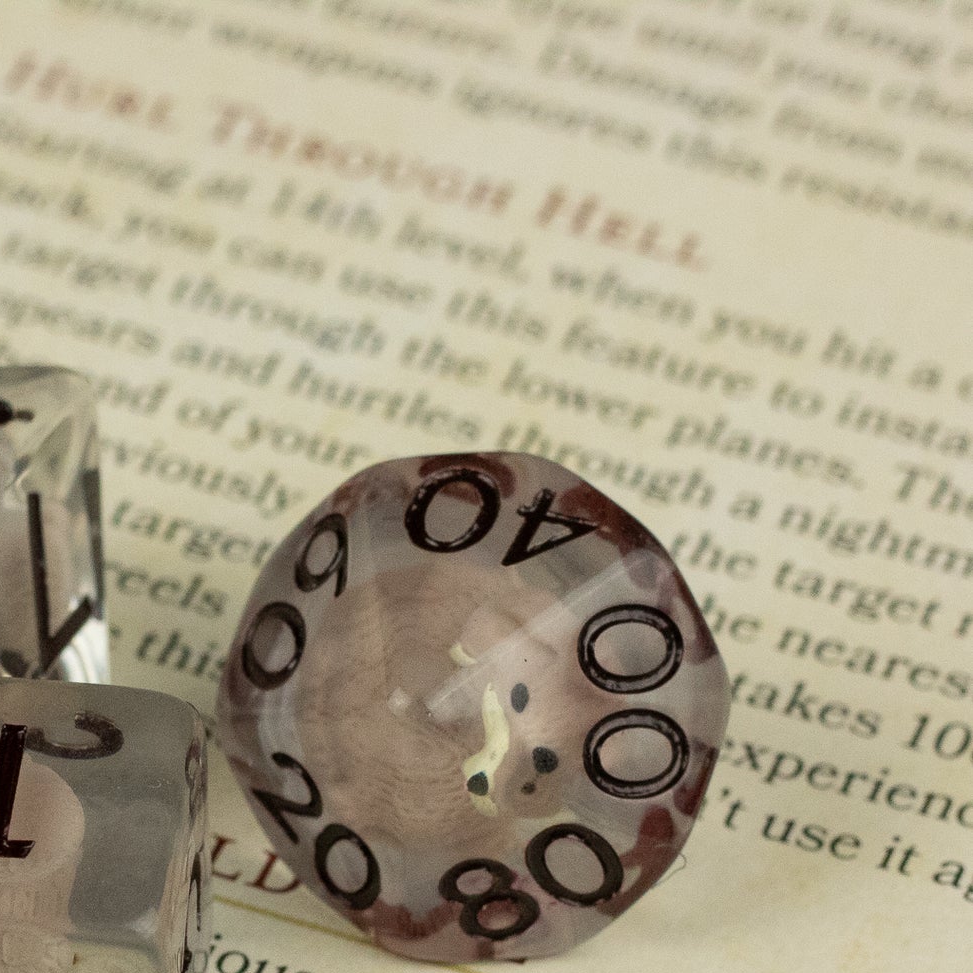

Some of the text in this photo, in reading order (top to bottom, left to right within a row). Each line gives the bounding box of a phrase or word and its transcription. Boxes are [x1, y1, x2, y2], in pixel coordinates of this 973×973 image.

[445, 290, 549, 342] this
[562, 316, 757, 395] feature
[770, 380, 825, 417] to
[549, 262, 697, 328] when
[699, 308, 810, 357] you
[822, 328, 897, 380] hit
[909, 362, 944, 392] a
[170, 272, 389, 357] through
[400, 335, 489, 382] the
[502, 358, 659, 432] lower
[665, 412, 867, 490] planes.
[172, 337, 279, 388] and
[289, 362, 482, 442] hurtles
[729, 490, 763, 522] a
[177, 402, 241, 434] of
[769, 560, 942, 642] target
[727, 670, 884, 742] takes
[762, 812, 922, 877] use it
